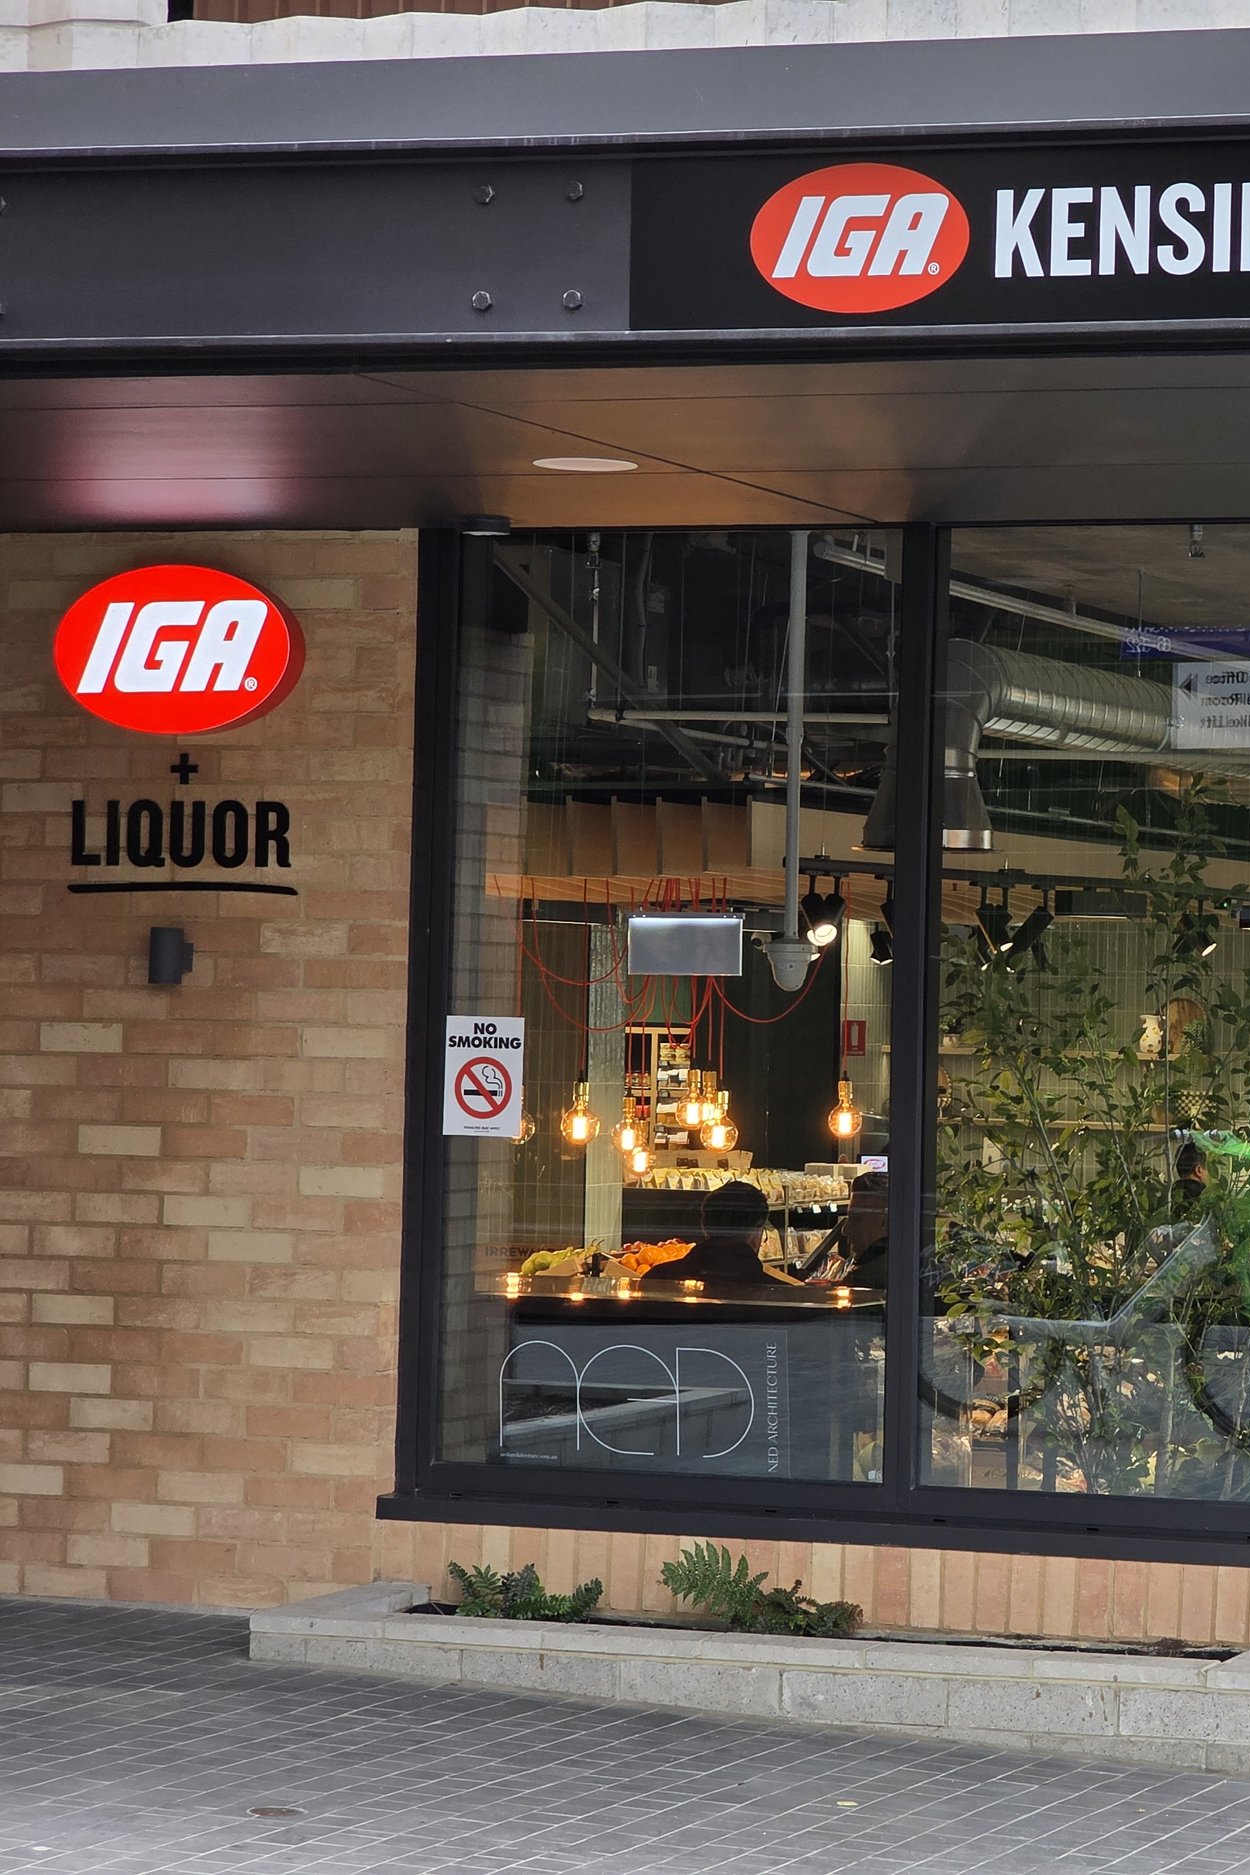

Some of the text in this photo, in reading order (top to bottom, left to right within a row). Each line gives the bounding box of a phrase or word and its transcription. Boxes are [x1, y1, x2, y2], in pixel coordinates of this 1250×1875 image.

[70, 798, 292, 869] LIQUOR
[448, 1035, 522, 1049] SMOKING
[473, 1022, 497, 1035] NO
[766, 1341, 778, 1473] NED ARCHITECTURE
